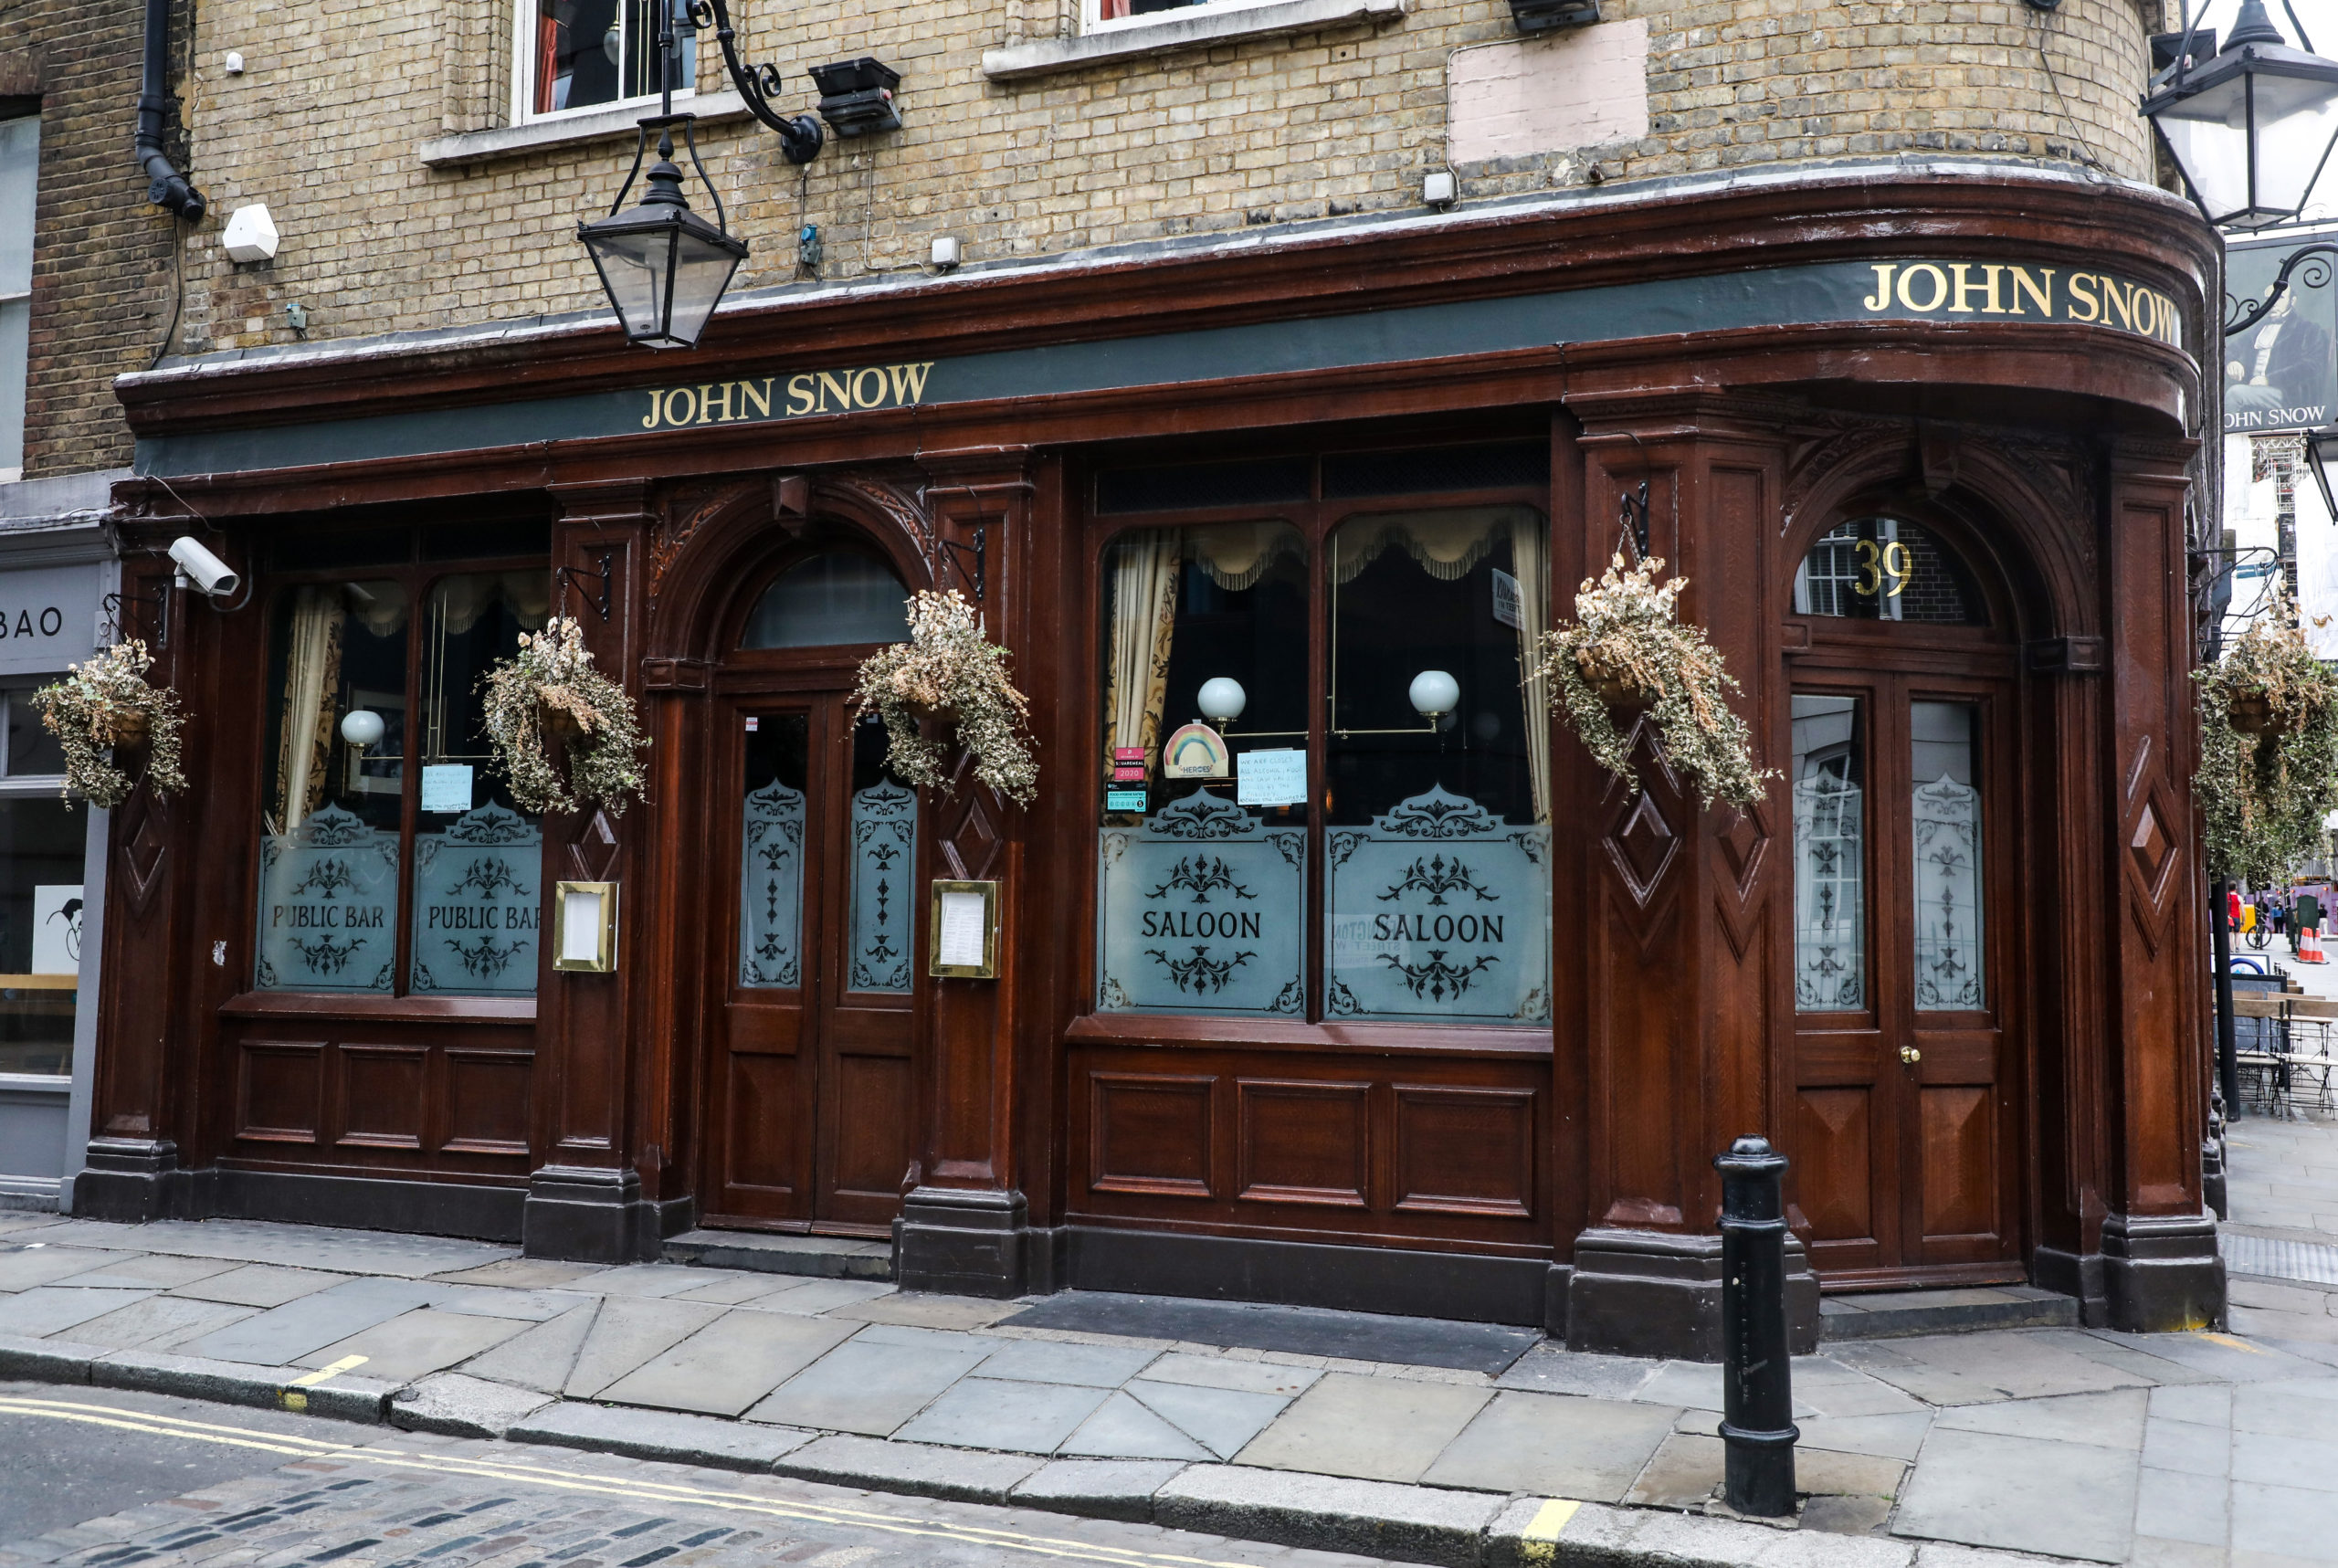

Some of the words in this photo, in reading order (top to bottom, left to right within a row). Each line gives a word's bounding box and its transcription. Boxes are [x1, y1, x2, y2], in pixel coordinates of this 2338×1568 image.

[1863, 263, 2056, 318] JOHN
[2067, 271, 2175, 344] SNOW
[642, 377, 775, 428] JOHN
[785, 362, 935, 416] SNOW
[2224, 410, 2262, 428] OHN
[2268, 405, 2326, 426] SNOW
[1854, 539, 1912, 597] 39
[272, 905, 339, 928] PUBLIC
[344, 905, 384, 928] BAR
[428, 906, 499, 929] PUBLIC
[1141, 911, 1260, 939] SALOON
[1373, 913, 1504, 942] SALOON
